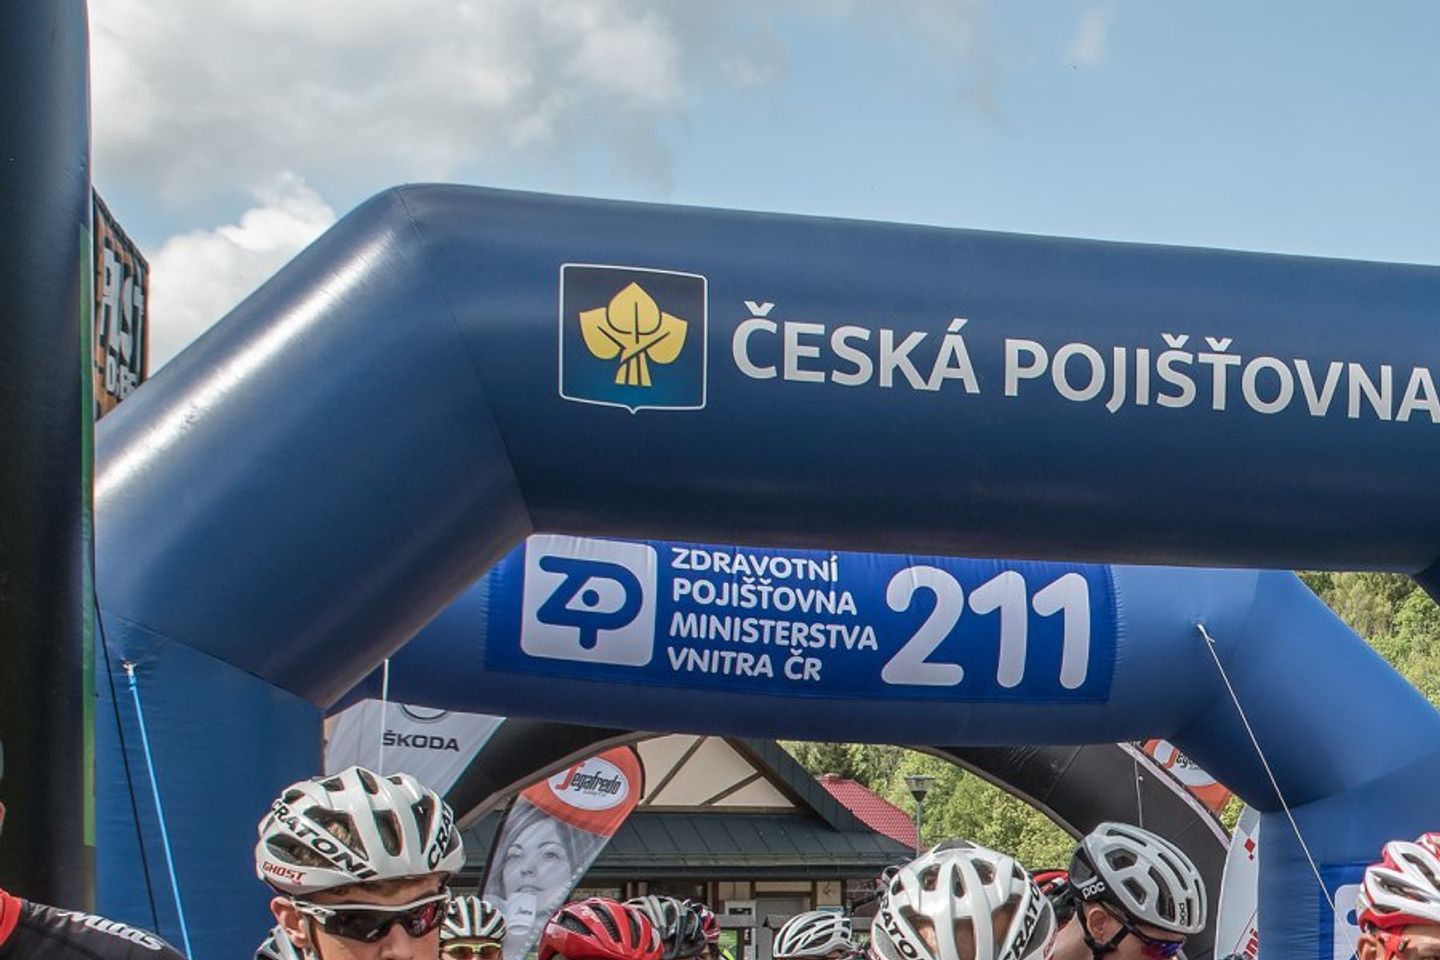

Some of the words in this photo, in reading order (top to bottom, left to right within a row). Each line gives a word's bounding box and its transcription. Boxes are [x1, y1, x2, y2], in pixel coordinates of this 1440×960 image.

[731, 301, 980, 394] ČESKÁ
[671, 547, 838, 582] ZDRAVOTNÍ
[673, 577, 857, 615] POJIŠŤOVNA
[669, 612, 878, 651] MINISTERSTVA
[881, 565, 1090, 689] 211
[666, 646, 775, 680] VNITRA
[783, 648, 822, 681] ČR
[382, 729, 460, 752] ŠKODA
